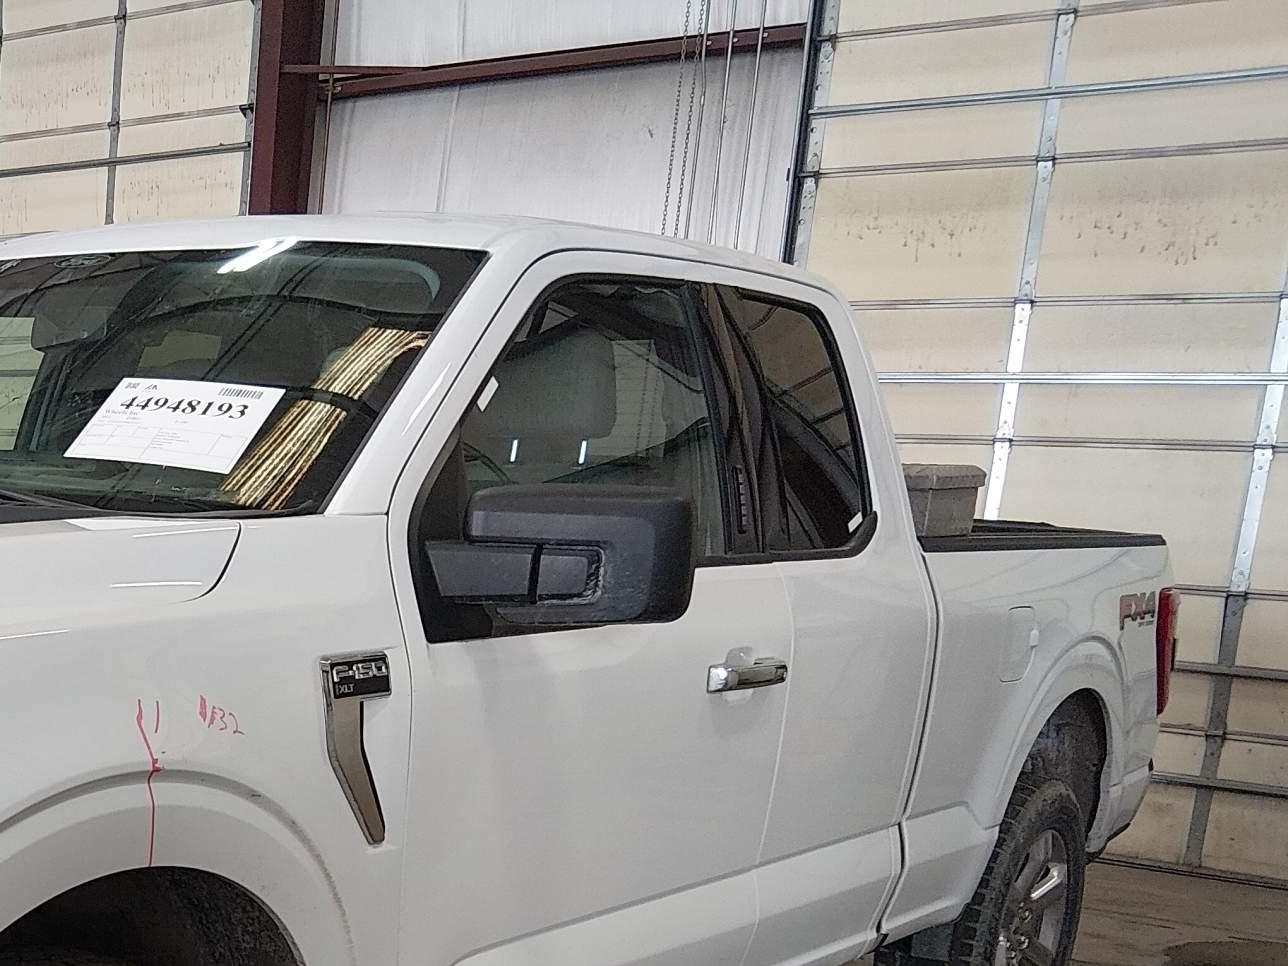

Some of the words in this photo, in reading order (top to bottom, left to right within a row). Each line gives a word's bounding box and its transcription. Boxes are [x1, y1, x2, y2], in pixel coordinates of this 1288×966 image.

[120, 396, 249, 420] 44948193
[333, 661, 387, 682] F-150
[339, 683, 355, 694] XLT
